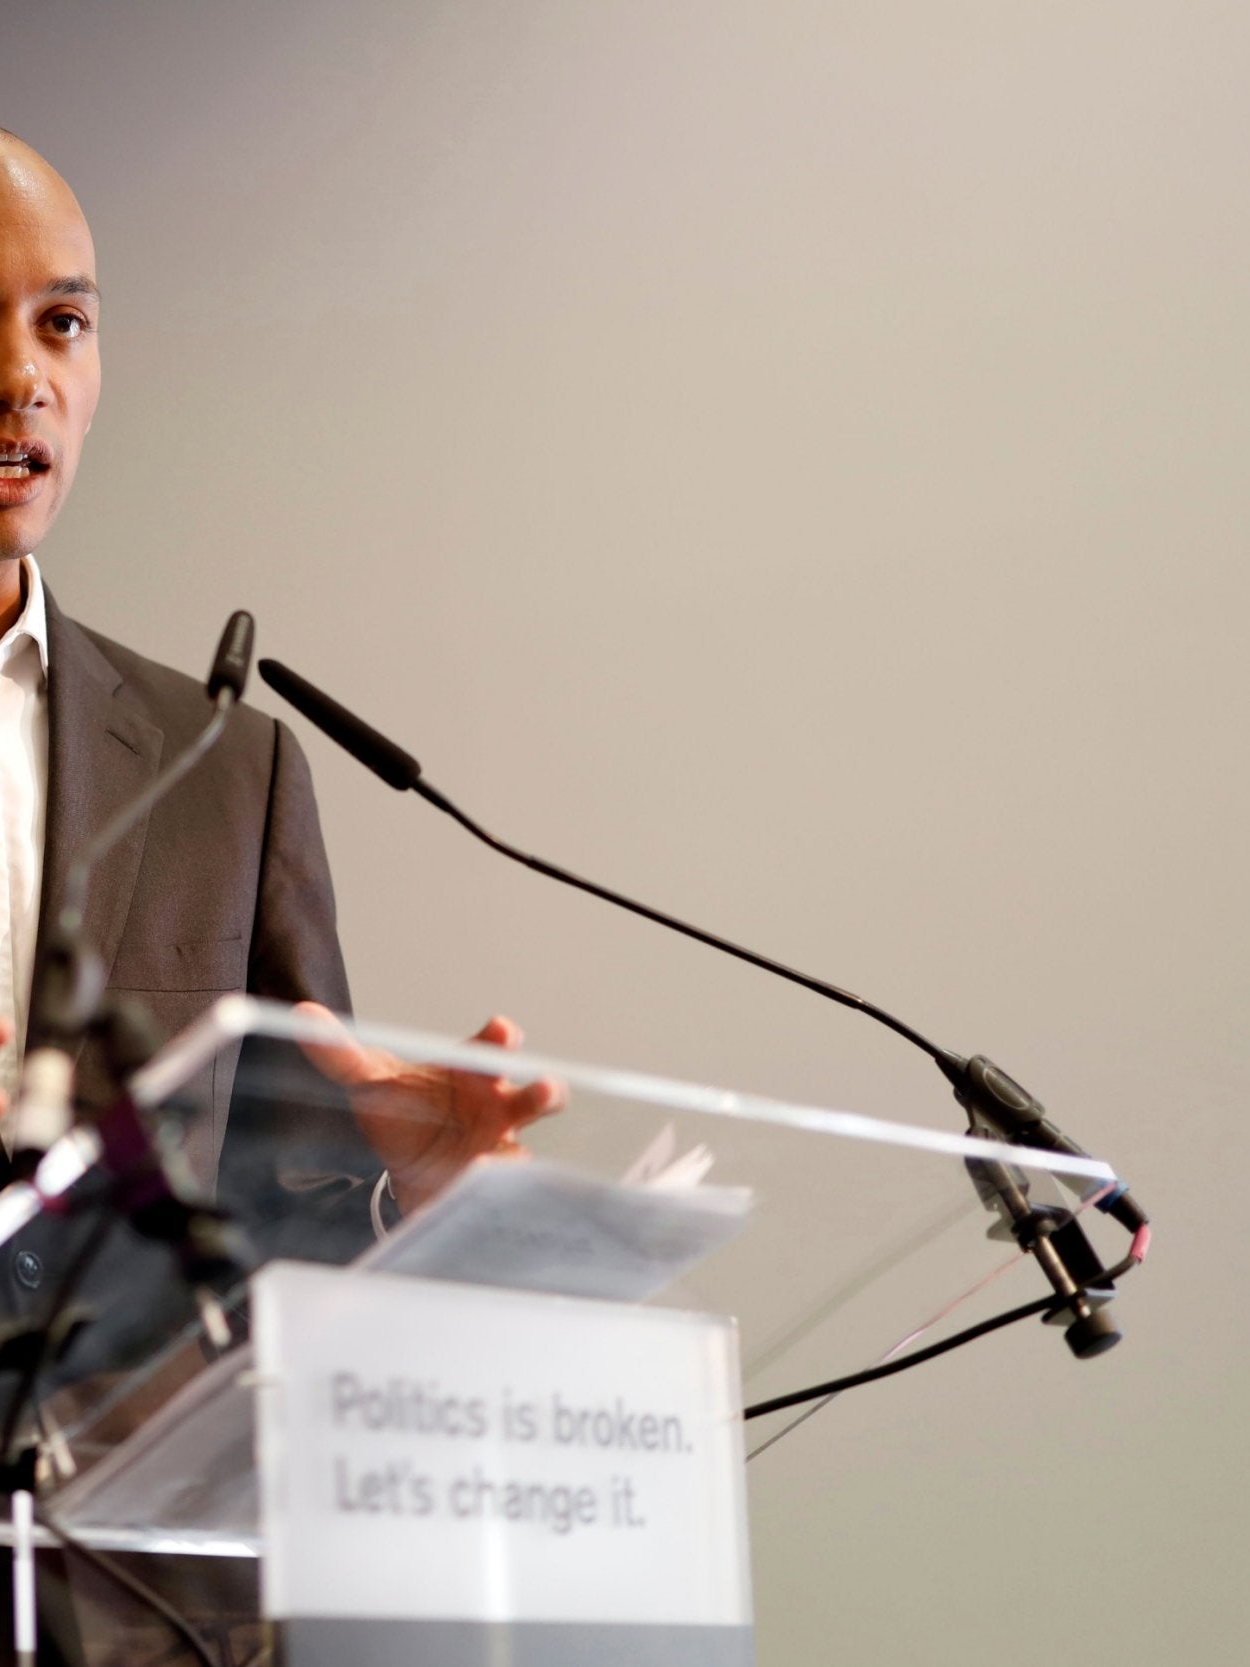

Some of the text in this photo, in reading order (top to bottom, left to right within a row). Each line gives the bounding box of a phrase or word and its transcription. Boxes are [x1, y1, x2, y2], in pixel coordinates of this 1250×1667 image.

[330, 1370, 694, 1454] Politics is broken.
[334, 1456, 647, 1534] Let's change it.
